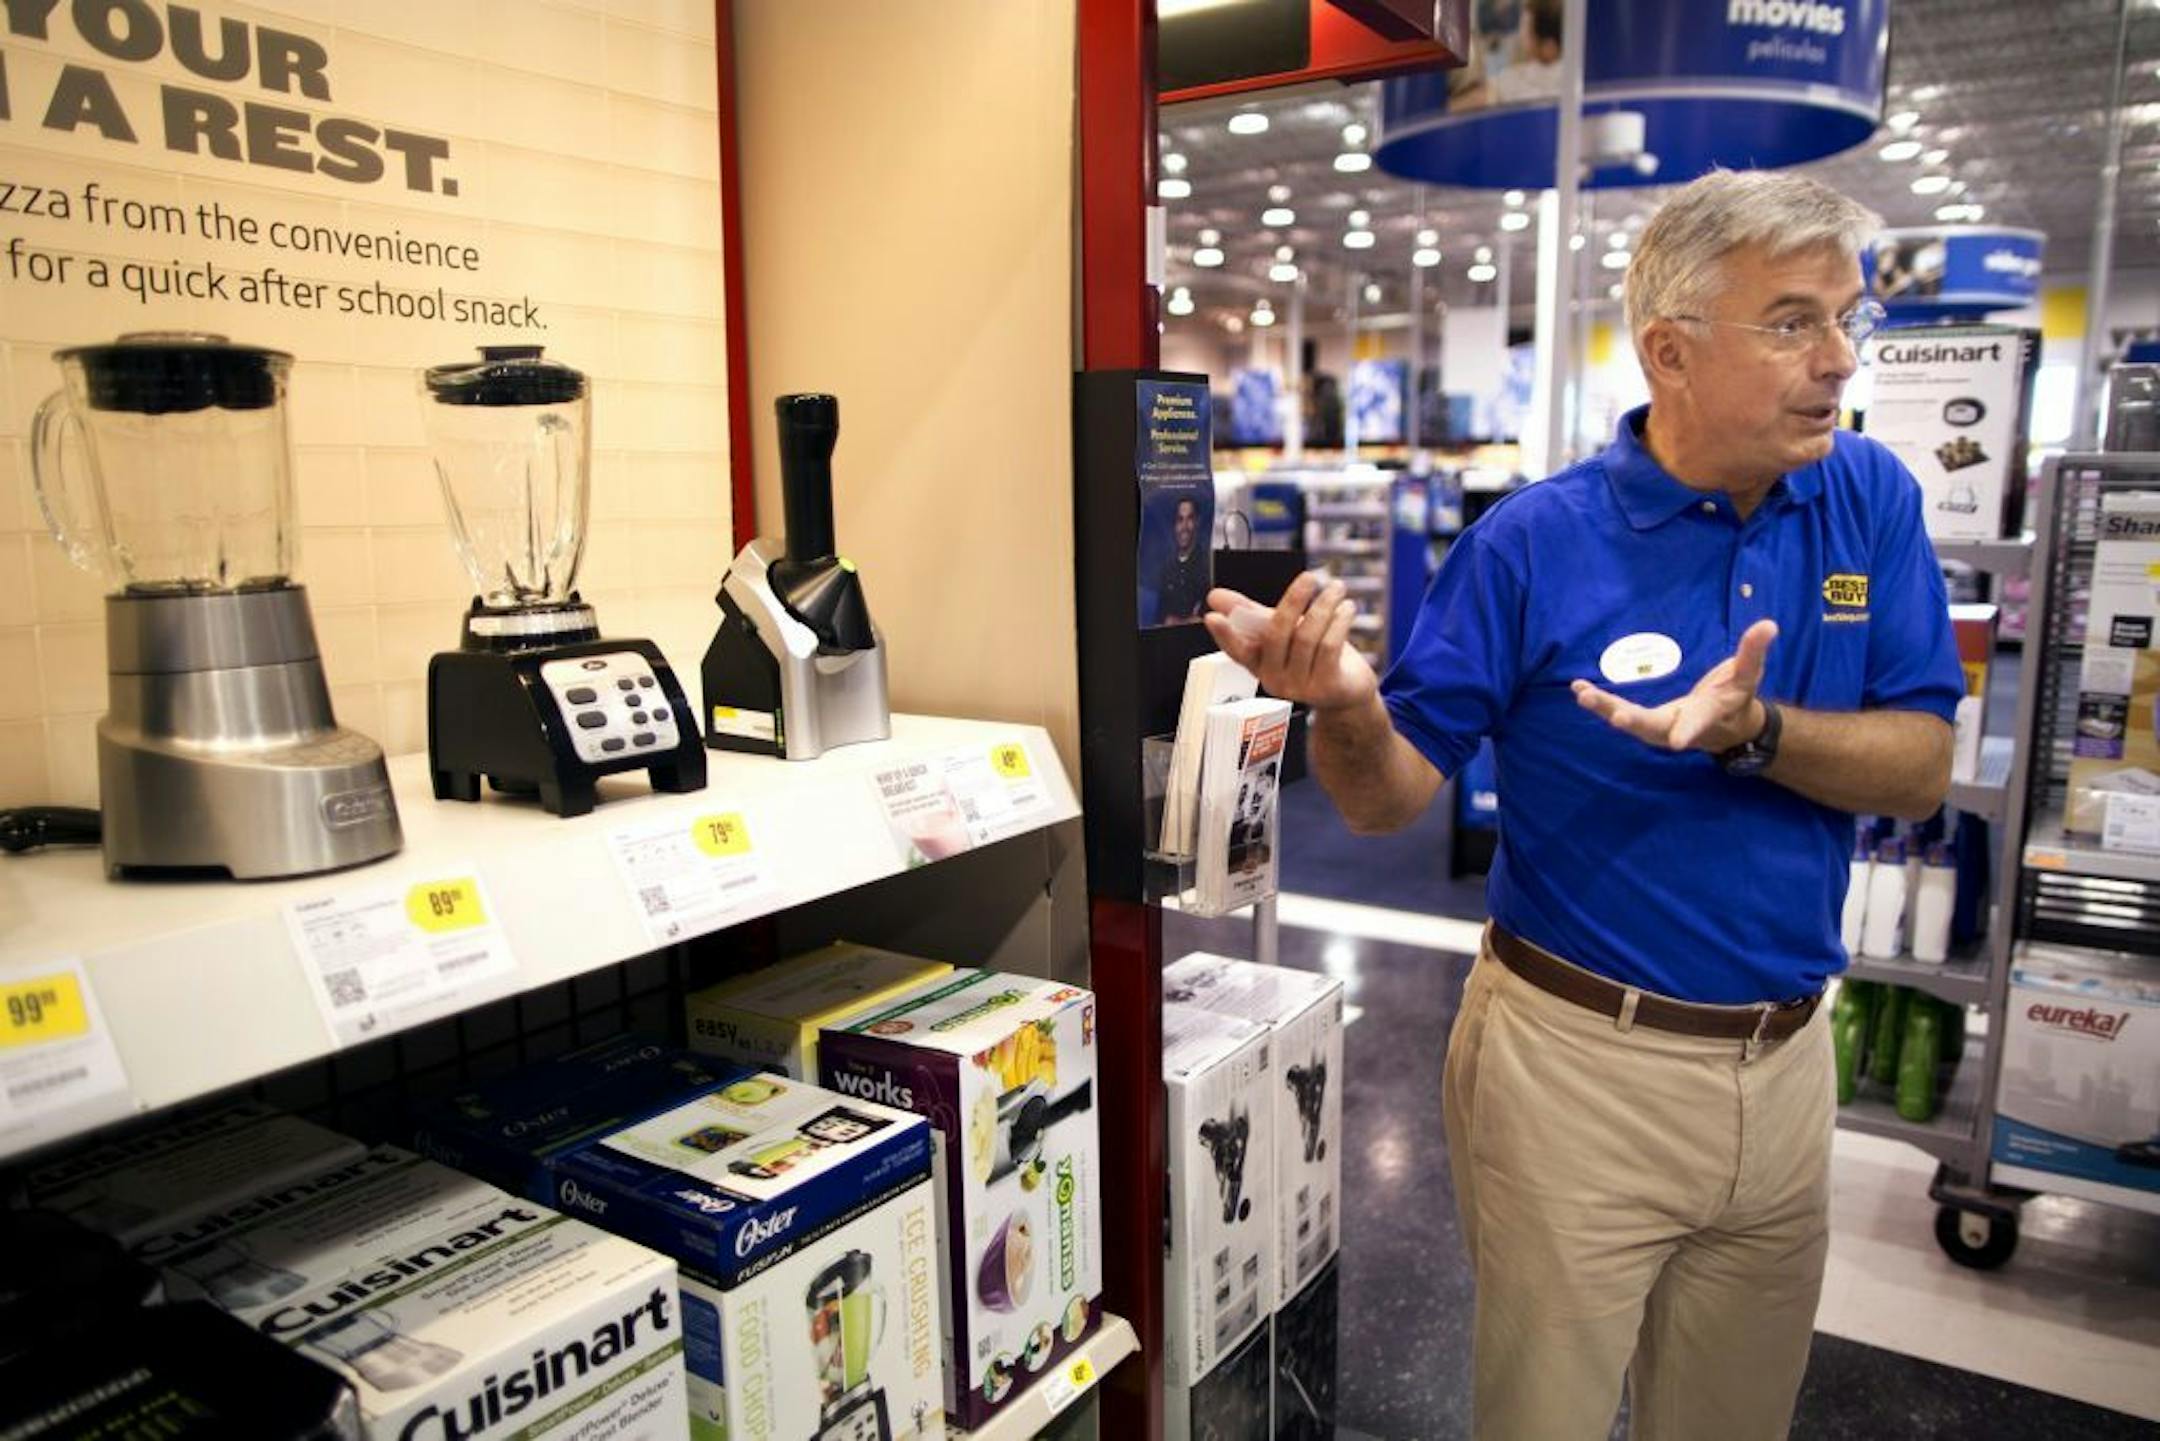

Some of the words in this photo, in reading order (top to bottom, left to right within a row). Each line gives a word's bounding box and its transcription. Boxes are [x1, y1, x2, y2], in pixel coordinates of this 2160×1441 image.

[1727, 0, 1845, 35] movies
[6, 0, 331, 101] YOUR
[42, 64, 139, 144] A
[160, 84, 459, 196] REST.
[82, 183, 186, 236] from
[196, 202, 259, 244] the
[269, 217, 481, 272] convenience
[6, 238, 74, 284] for
[87, 259, 109, 288] a
[121, 258, 229, 304] quick
[240, 268, 328, 311] after
[338, 280, 445, 322] school
[454, 297, 549, 330] snack.
[1878, 342, 2002, 365] Cuisinart
[1829, 580, 1867, 592] BEST
[1831, 590, 1867, 603] BUY
[696, 1018, 737, 1045] easy
[2027, 1003, 2131, 1041] eureka!
[834, 1070, 914, 1109] works
[131, 1152, 400, 1257] Cuisinart
[560, 1178, 609, 1216] Oster
[1056, 1154, 1077, 1293] yonanas
[735, 1205, 799, 1258] Oster
[905, 1206, 926, 1250] ICE
[259, 1207, 538, 1334] Cuisinart
[399, 1285, 669, 1441] Cuisinart
[741, 1373, 768, 1441] CHOP
